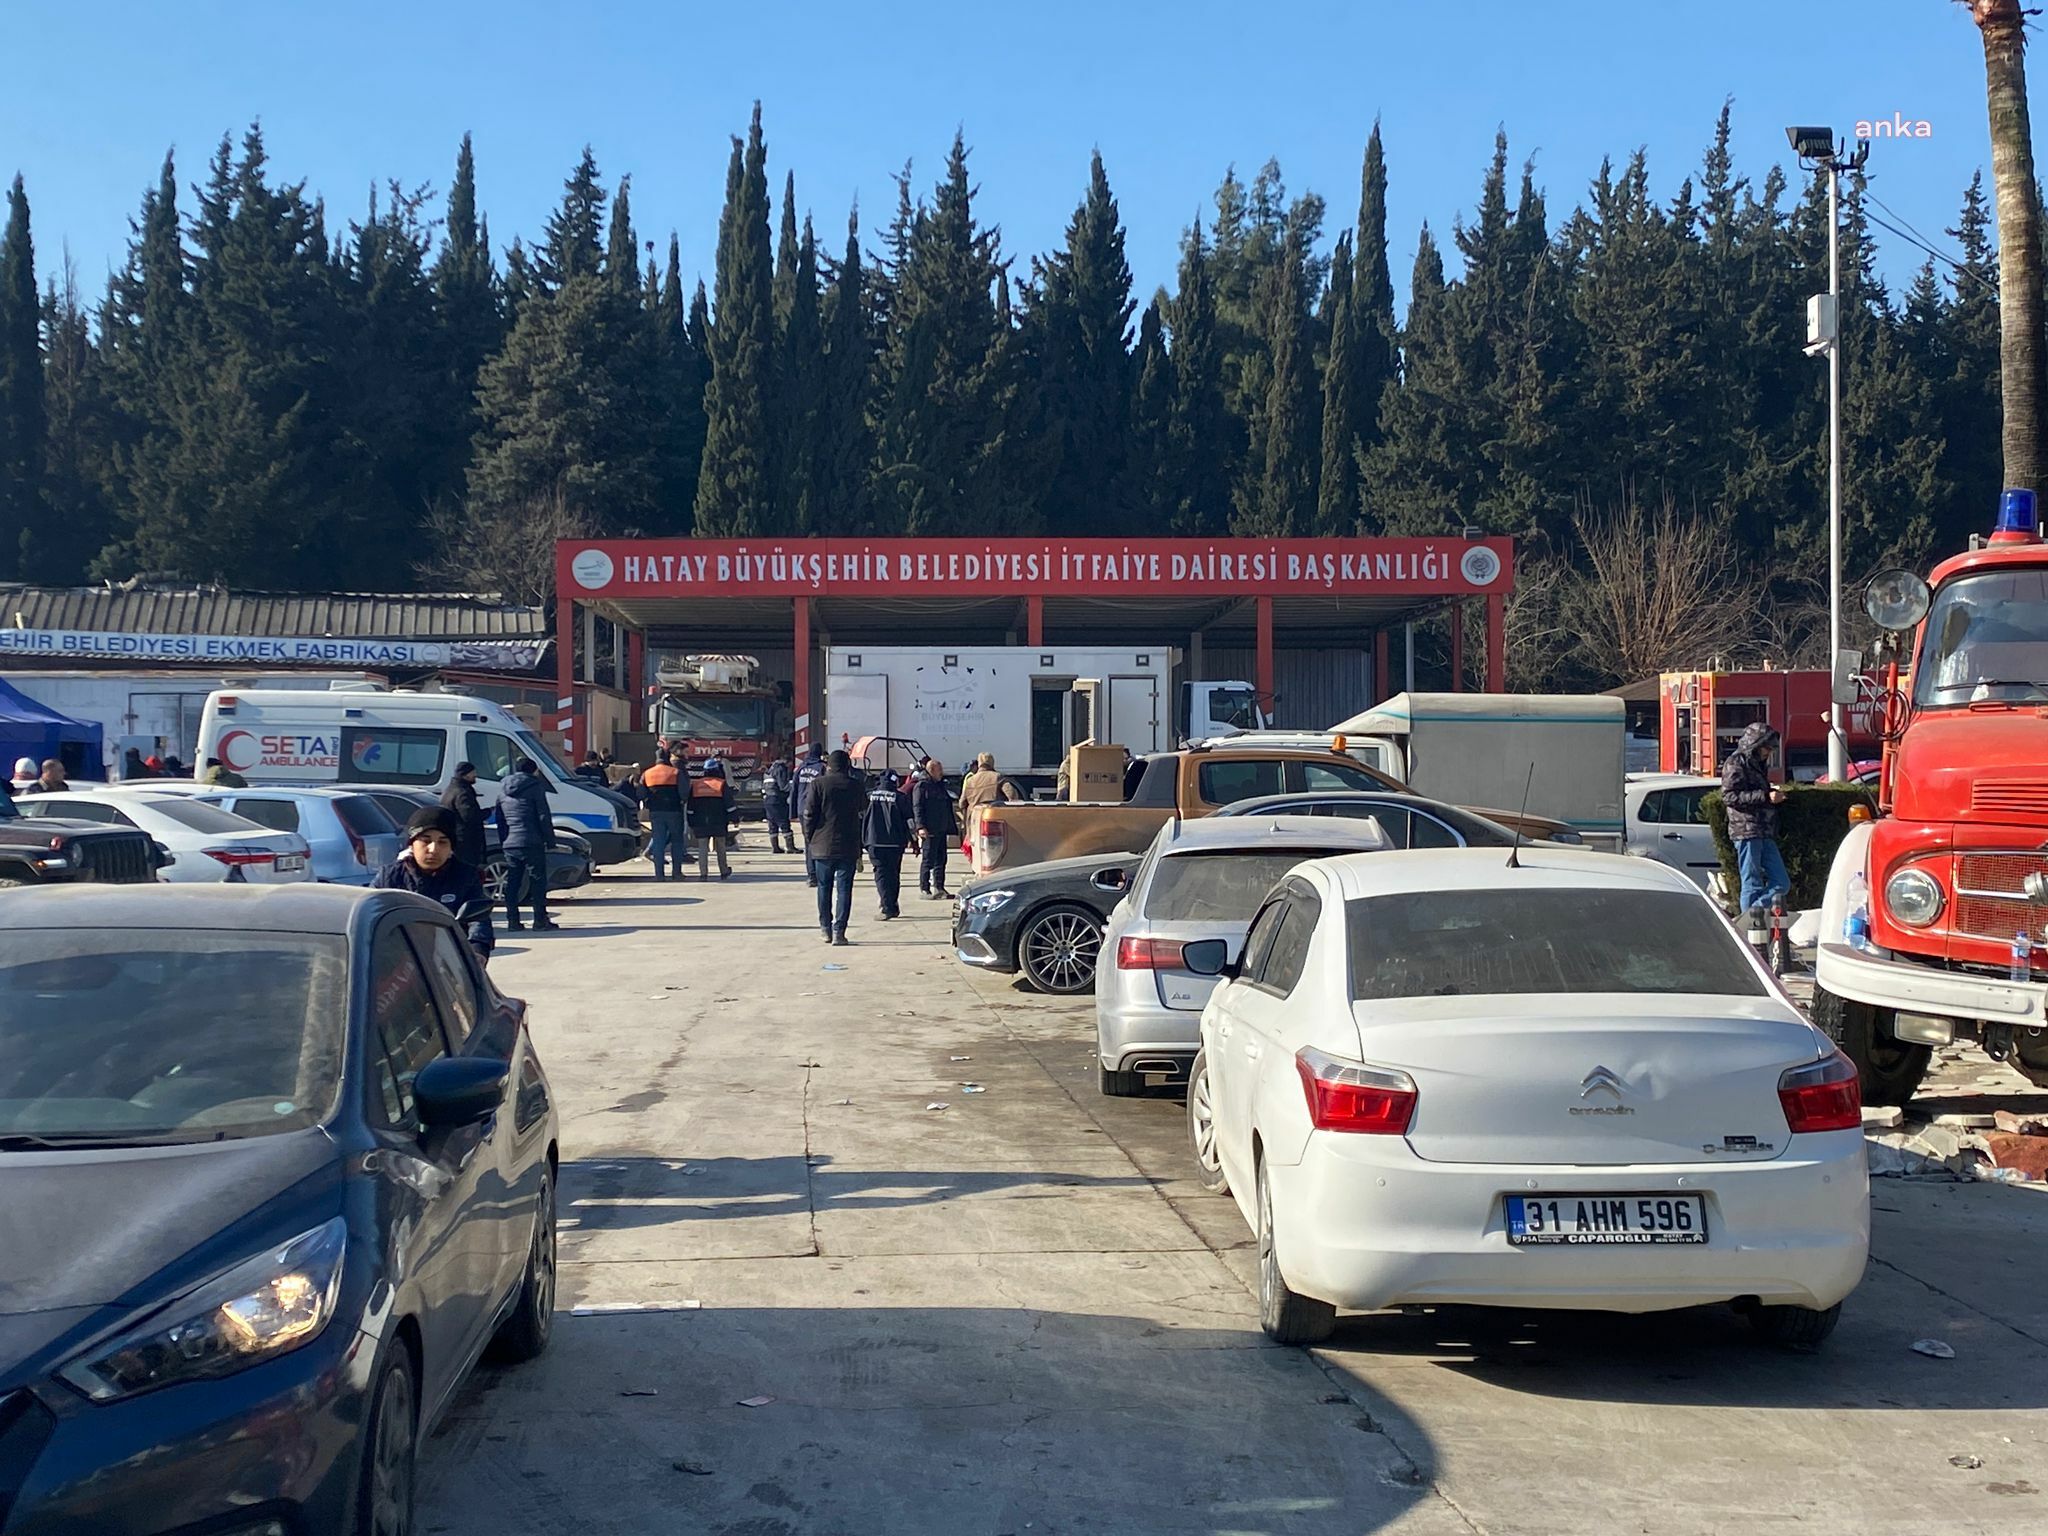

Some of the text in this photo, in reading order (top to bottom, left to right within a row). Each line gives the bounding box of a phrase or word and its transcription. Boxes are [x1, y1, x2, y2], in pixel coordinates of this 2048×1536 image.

[624, 545, 1449, 588] HATAY BÜYÜKŞEHİR BELEDİYESİ İTFAİYE DAİRESİ BAŞKANLIĞI
[63, 635, 197, 654] BELEDİYESİ
[206, 639, 287, 657] EKMEK
[295, 641, 415, 661] FABRİKASI
[261, 736, 328, 756] SETA
[259, 756, 338, 768] AMBULANCE
[1512, 1220, 1525, 1230] TR
[1527, 1201, 1692, 1232] 31 AHM 596
[1522, 1235, 1538, 1243] PSA
